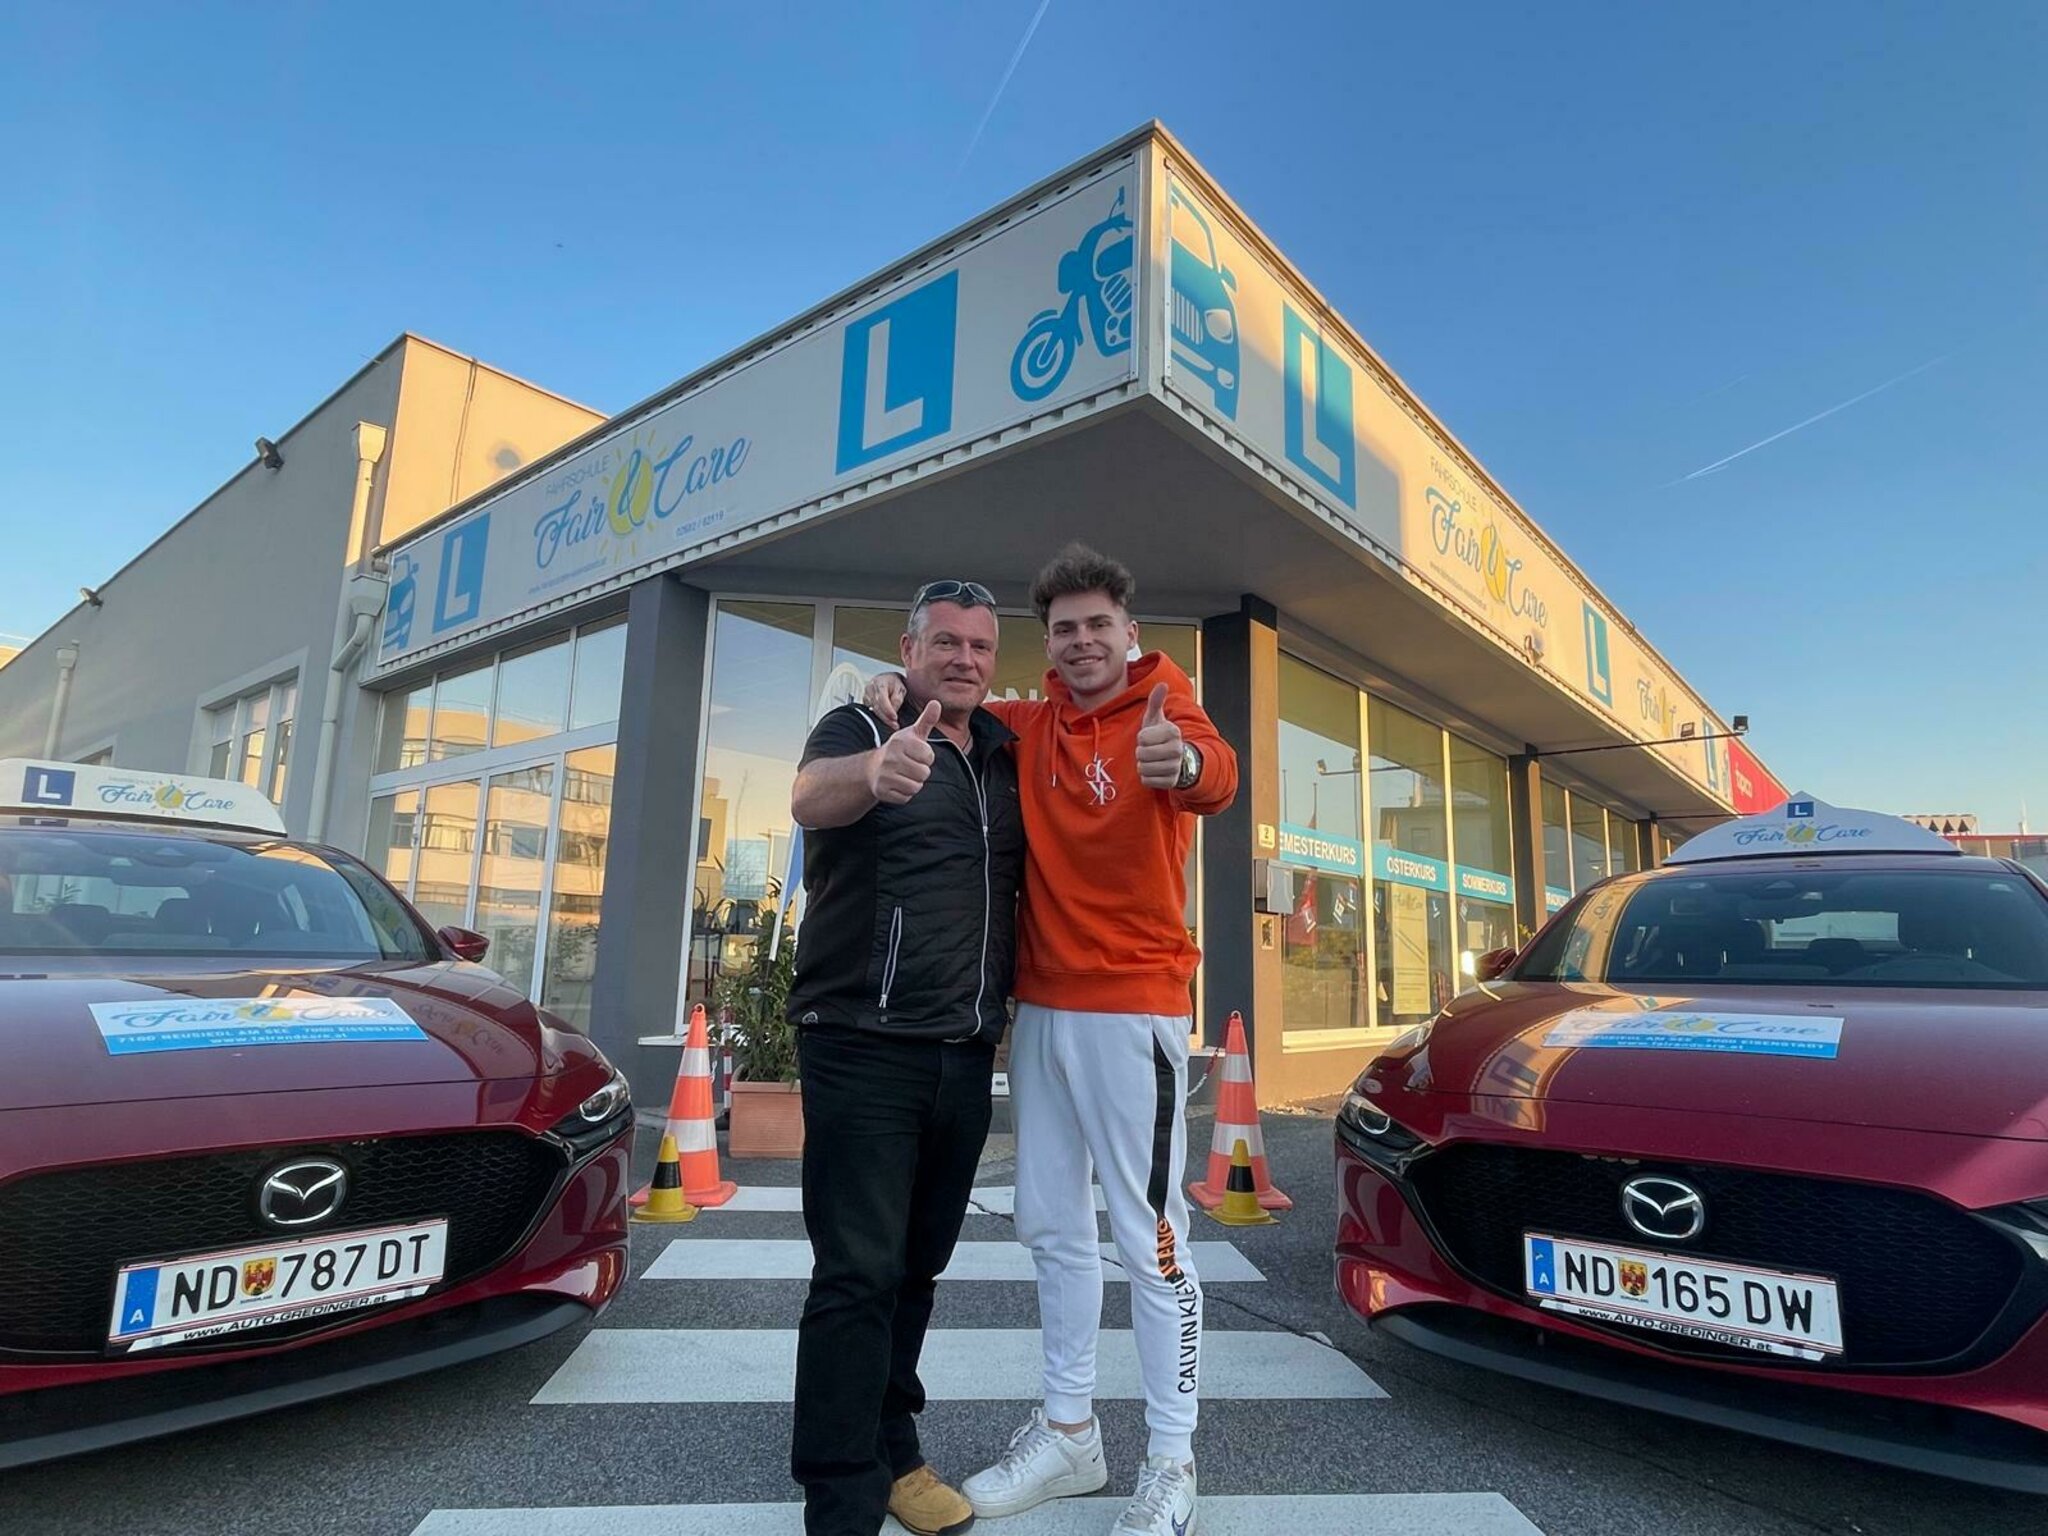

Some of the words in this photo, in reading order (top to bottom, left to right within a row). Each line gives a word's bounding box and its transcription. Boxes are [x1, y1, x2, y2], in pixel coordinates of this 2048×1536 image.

[862, 317, 923, 451] L
[1300, 331, 1341, 484] L
[534, 489, 606, 569] Fair
[653, 435, 752, 518] Care
[1426, 486, 1482, 573] Fair
[1505, 558, 1547, 629] Care
[37, 774, 62, 800] L
[97, 783, 154, 804] Fair
[183, 790, 236, 811] Care
[1794, 804, 1809, 816] L
[1280, 832, 1356, 866] EMESTERKURS
[1733, 828, 1784, 845] Fair
[1815, 824, 1874, 842] Care
[1386, 856, 1437, 882] OSTERKURS
[110, 1008, 237, 1029] Fair
[1716, 1020, 1826, 1035] Care
[171, 1264, 239, 1318] ND
[281, 1243, 368, 1299] 787
[377, 1233, 431, 1281] DT
[1538, 1271, 1549, 1285] A
[1563, 1250, 1615, 1297] ND
[1651, 1266, 1731, 1319] 165
[1743, 1280, 1813, 1334] DW
[129, 1308, 144, 1324] A
[182, 1293, 388, 1341] www.AUTO-GREDINGER.at
[1578, 1306, 1773, 1352] www.AUTO-GREDINGER.at
[1177, 1320, 1198, 1394] CALVIN
